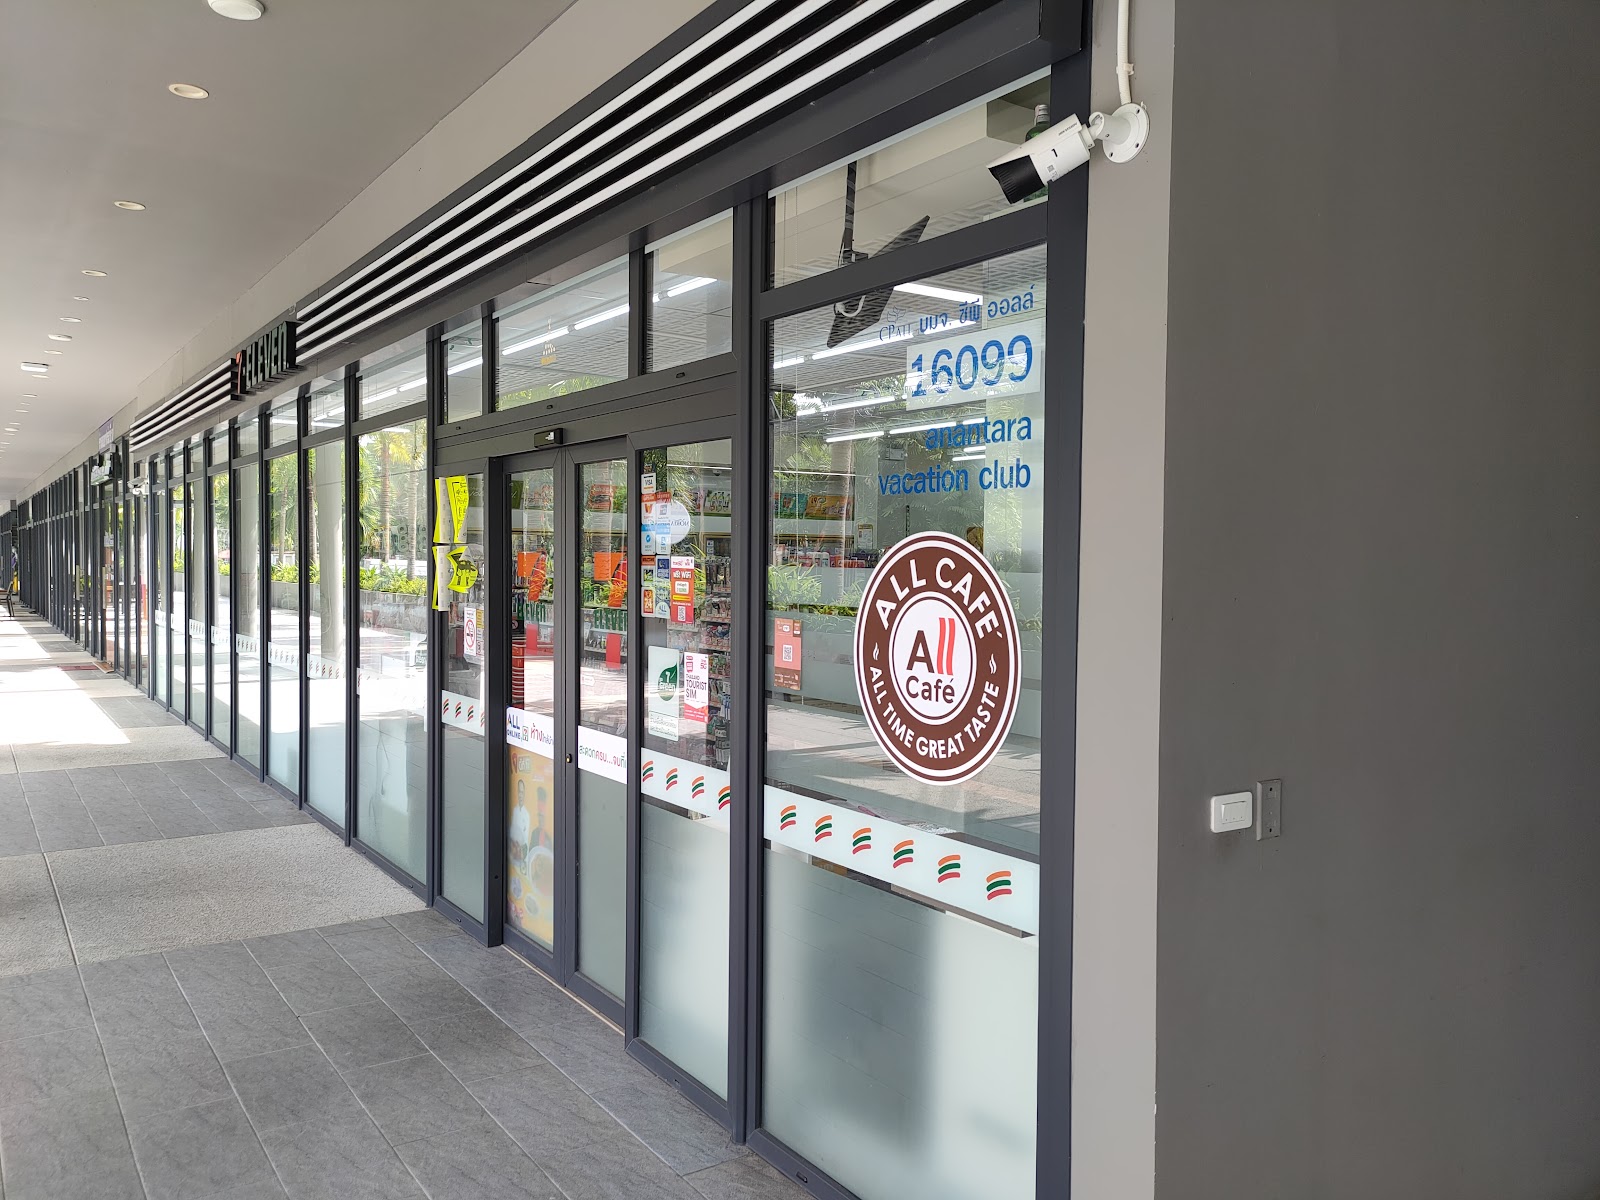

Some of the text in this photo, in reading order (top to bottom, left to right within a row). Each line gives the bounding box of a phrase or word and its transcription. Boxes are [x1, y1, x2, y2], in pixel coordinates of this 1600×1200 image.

[987, 283, 1035, 319] ออลล์
[911, 334, 1033, 397] 16099
[925, 416, 1031, 450] anantara
[878, 458, 1031, 495] vacation club
[875, 558, 927, 630] ALL
[685, 688, 697, 699] SIM
[686, 679, 707, 691] TOURIST
[905, 674, 956, 704] Café
[507, 713, 521, 730] ALL
[870, 666, 1000, 759] ALL TIME GREAT TASTE
